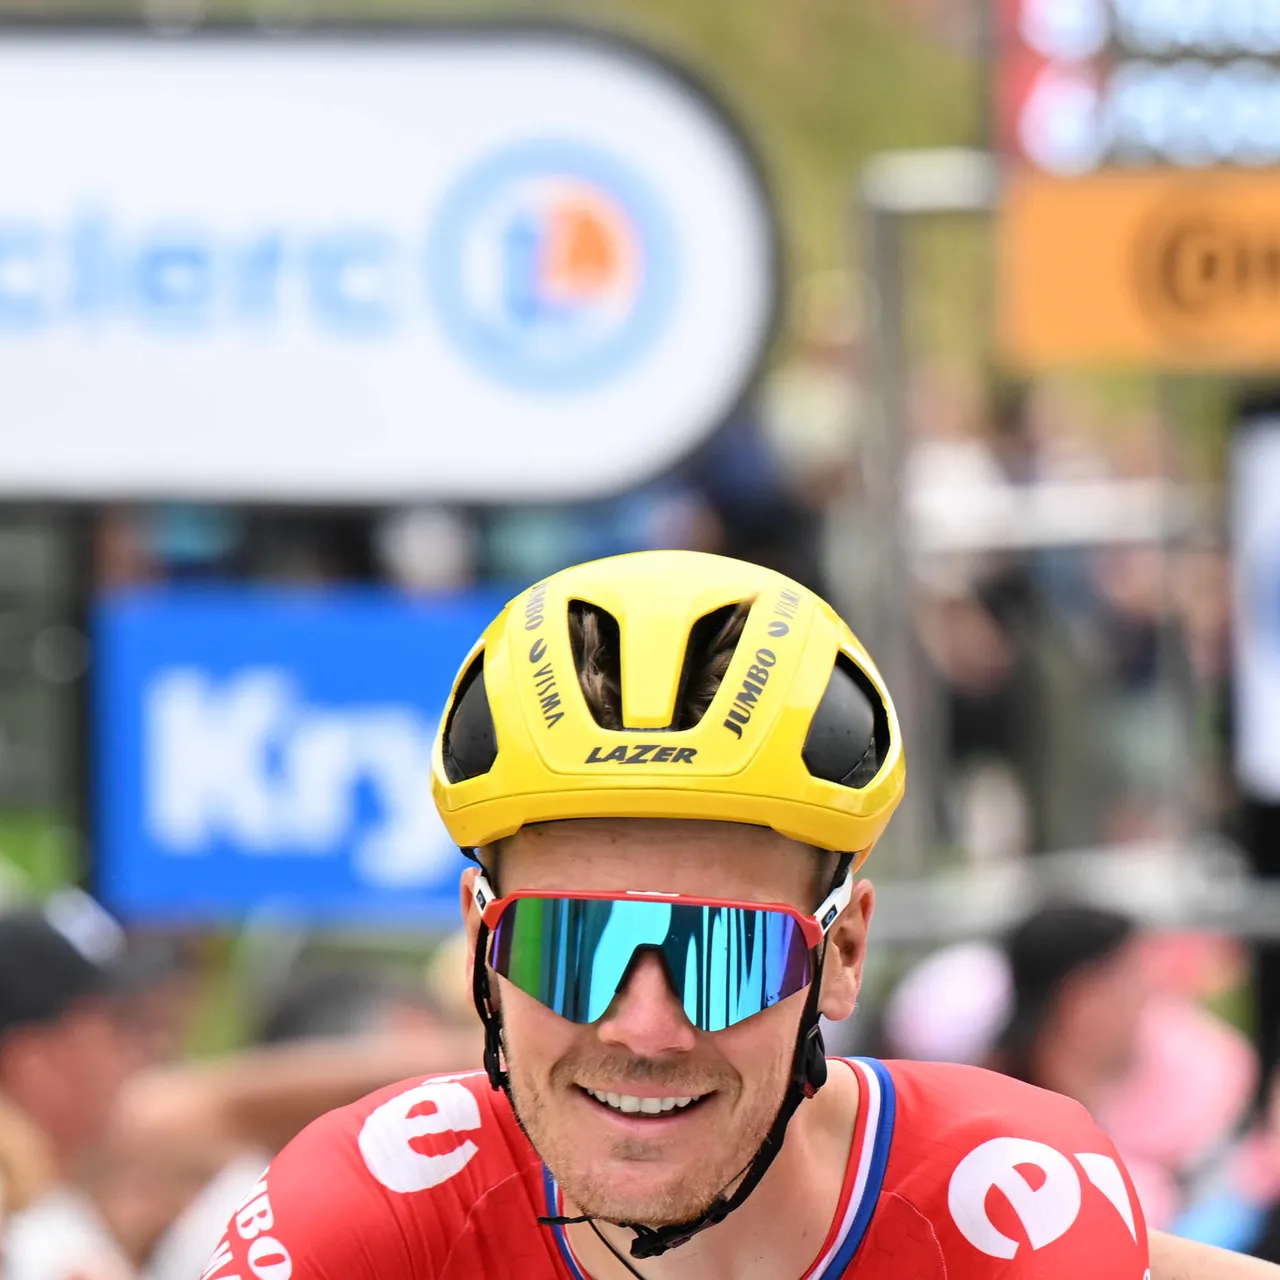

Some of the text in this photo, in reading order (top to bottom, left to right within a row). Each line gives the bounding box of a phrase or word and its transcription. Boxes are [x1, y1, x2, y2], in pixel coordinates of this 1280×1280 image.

[532, 660, 566, 730] VISMA
[722, 647, 778, 741] JUMBO
[583, 744, 699, 766] LAZER
